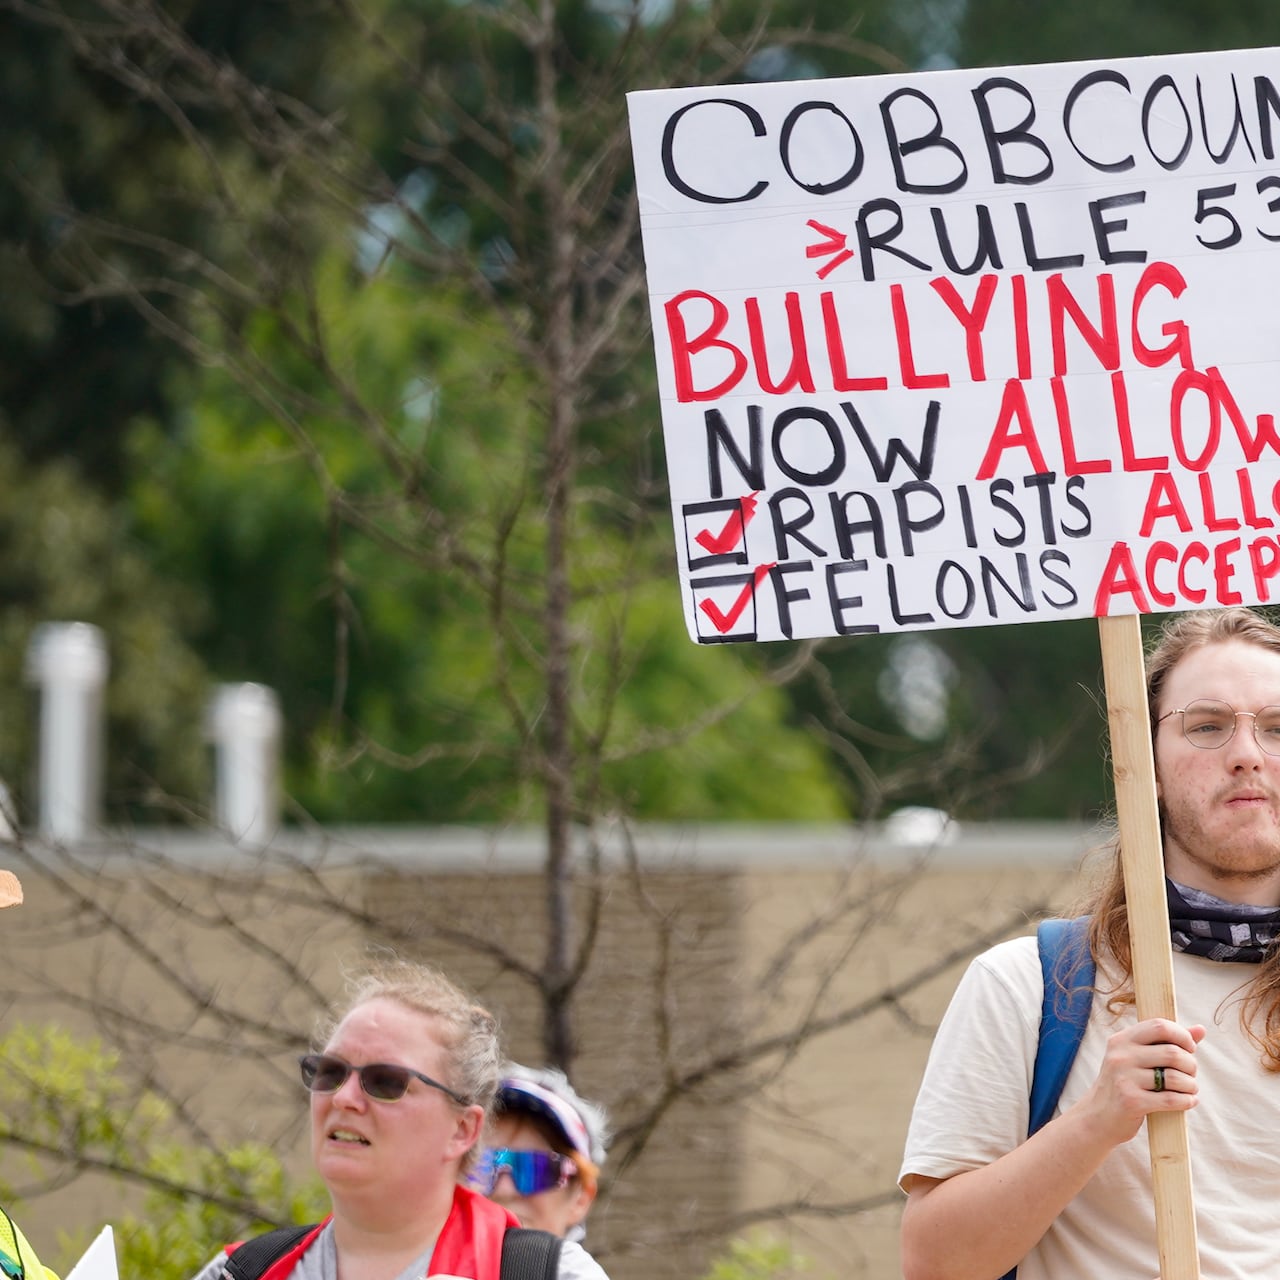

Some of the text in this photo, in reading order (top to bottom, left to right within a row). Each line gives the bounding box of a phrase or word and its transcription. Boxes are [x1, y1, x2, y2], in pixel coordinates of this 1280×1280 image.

[855, 190, 1147, 281] RULE
[664, 261, 1192, 403] BULLYING
[705, 401, 940, 499] NOW
[768, 472, 1091, 560] RAPISTS
[775, 550, 1077, 642] FELONS
